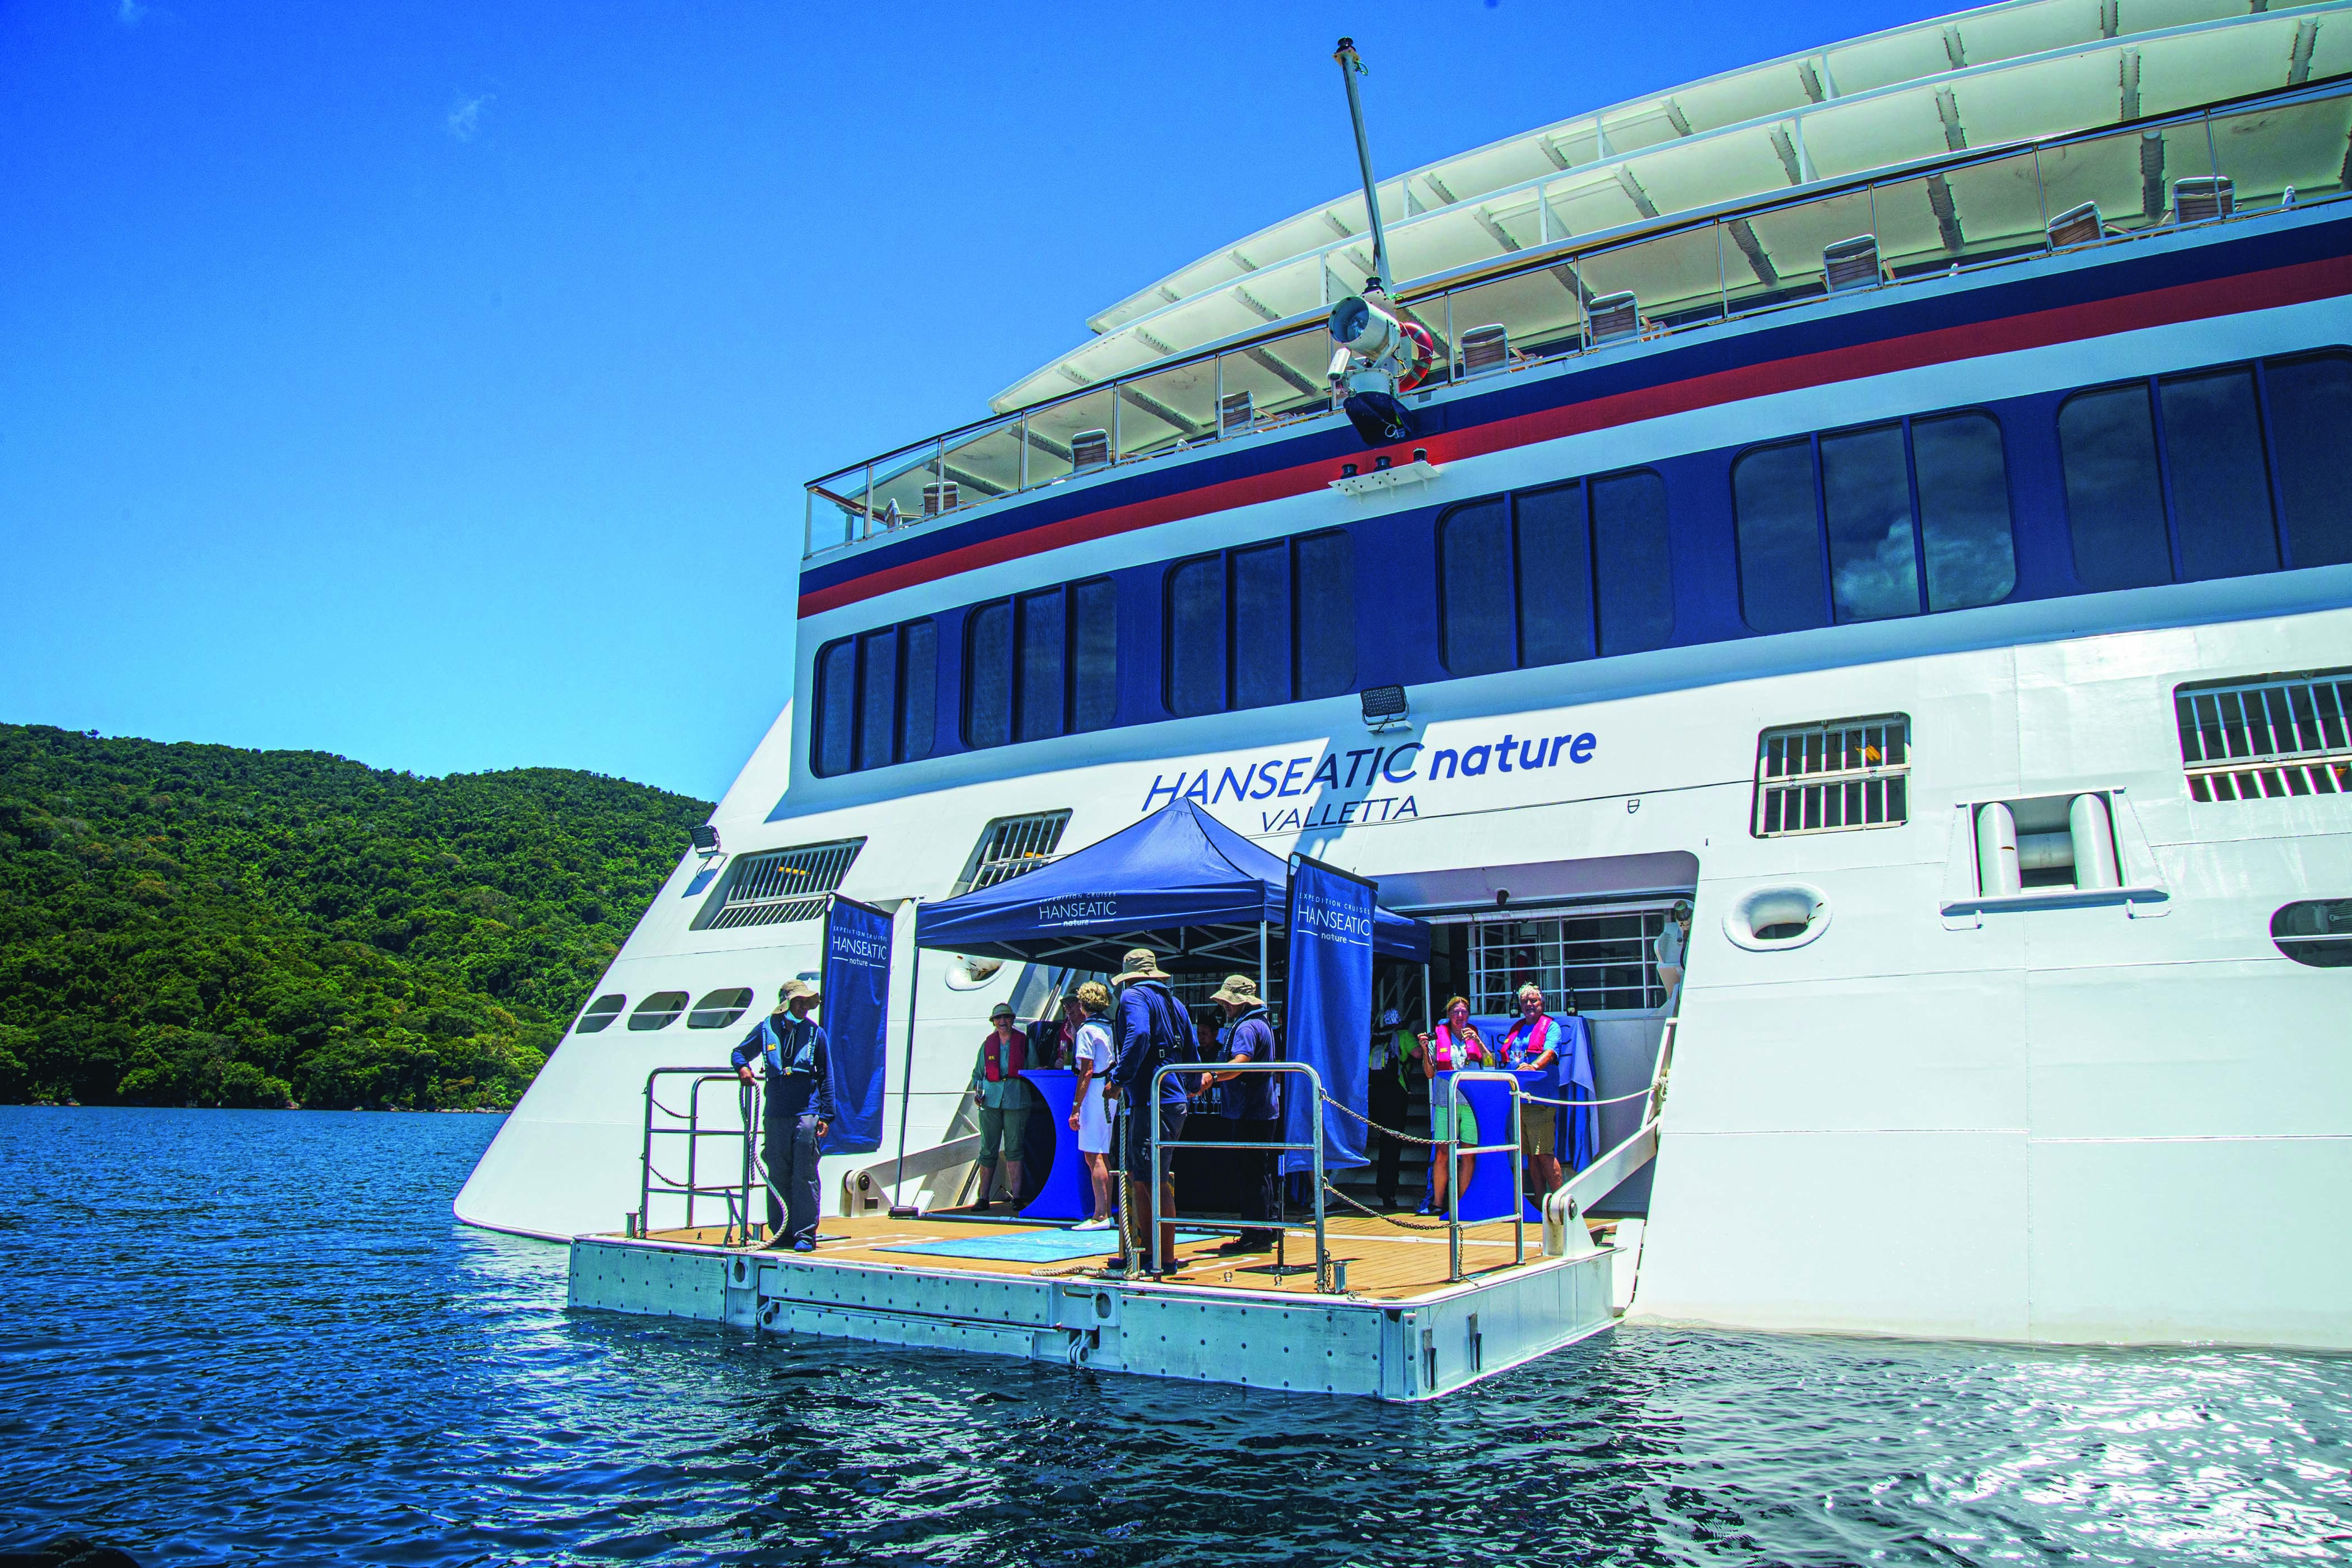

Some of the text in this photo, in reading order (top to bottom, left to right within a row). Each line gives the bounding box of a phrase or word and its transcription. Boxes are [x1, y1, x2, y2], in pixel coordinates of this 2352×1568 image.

[1142, 732, 1597, 811] HANSEATIC nature
[1262, 795, 1419, 832] VALLETTA
[1039, 901, 1117, 920] HANSEATIC
[1299, 893, 1370, 915] EXPEDITION CRUISES
[1298, 904, 1370, 936] HANSEATIC
[832, 936, 887, 960] HANSEATIC
[1322, 933, 1347, 943] nature
[849, 958, 868, 967] nature
